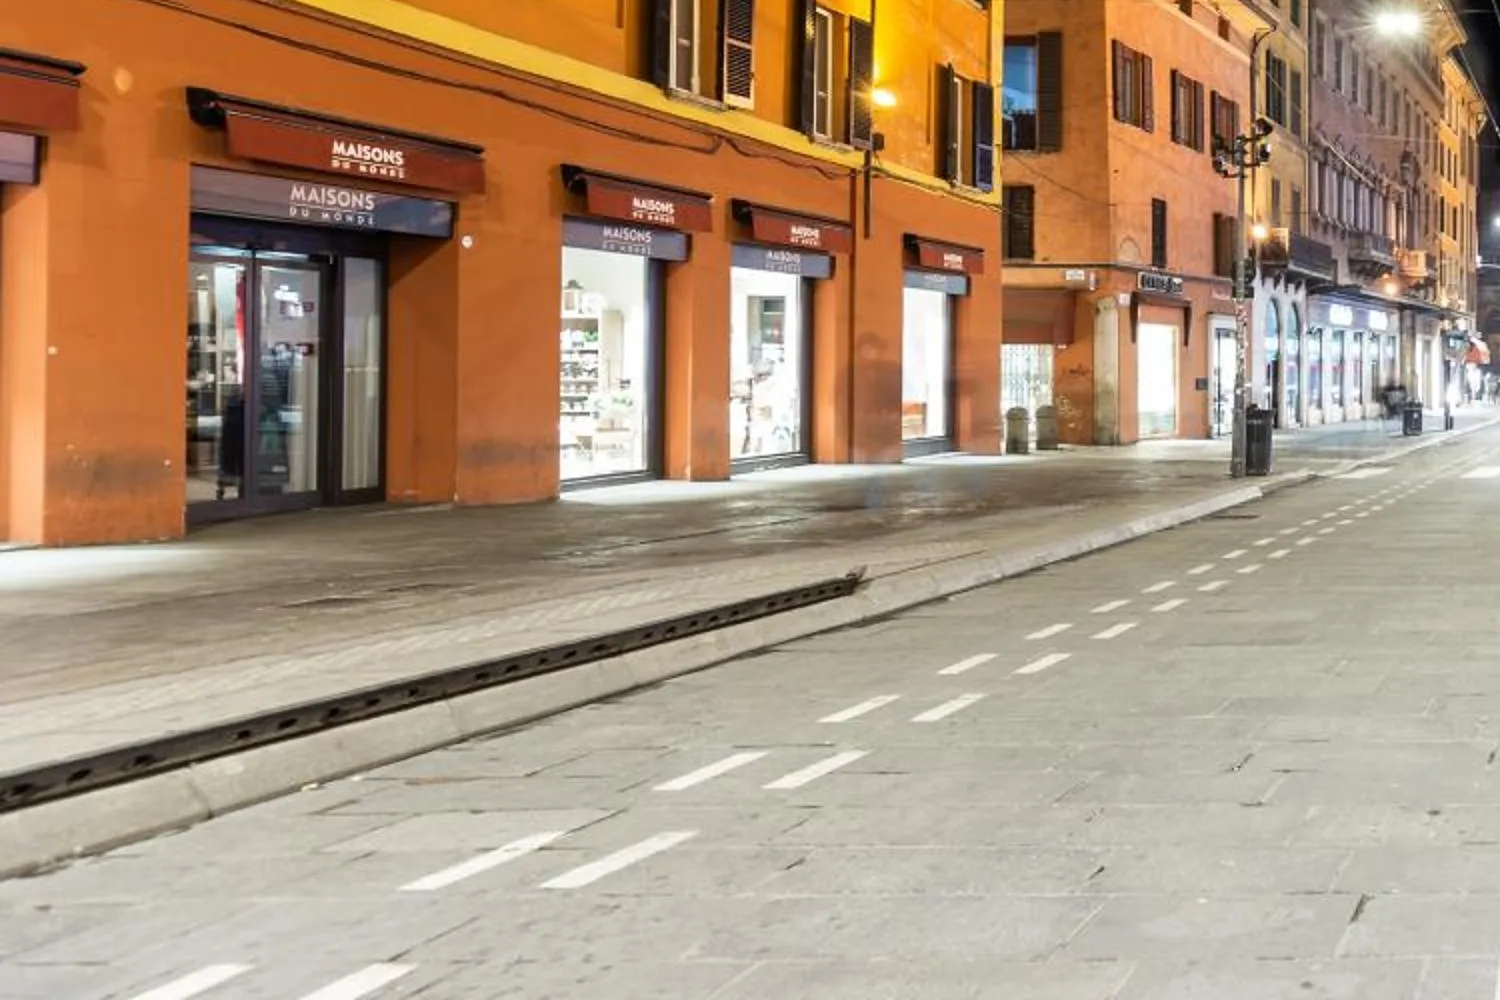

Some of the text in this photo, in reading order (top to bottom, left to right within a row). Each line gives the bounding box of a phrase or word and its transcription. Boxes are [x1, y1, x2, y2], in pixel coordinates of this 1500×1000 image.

[331, 140, 405, 165] MAISONS
[290, 184, 376, 211] MAISONS
[289, 206, 375, 226] DU MONDE
